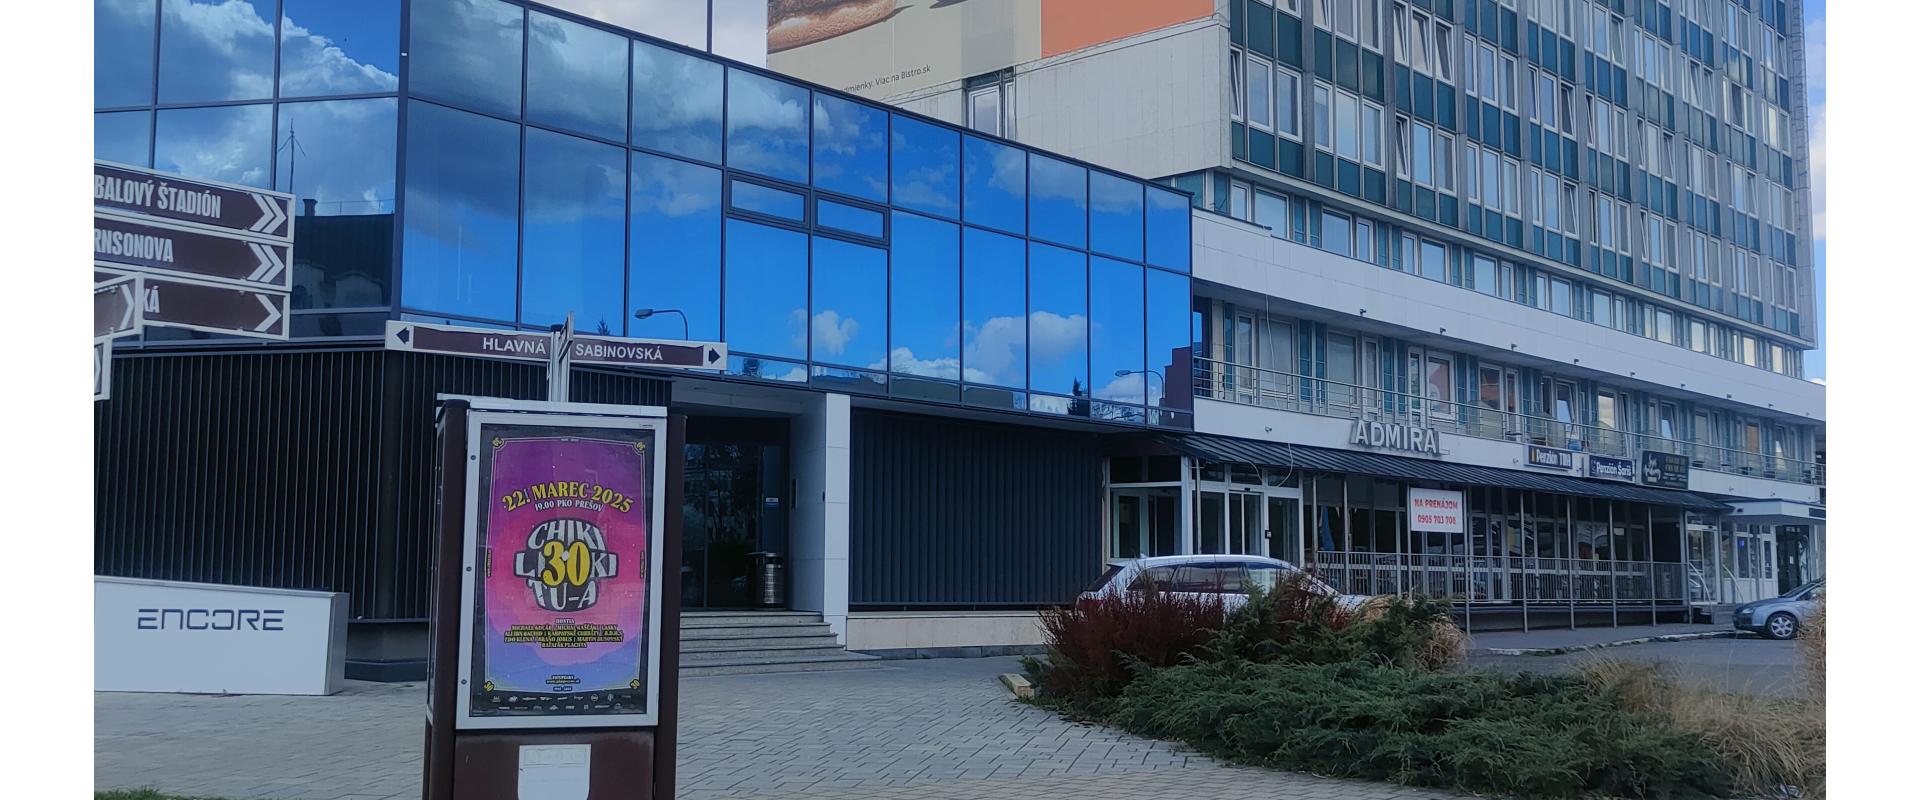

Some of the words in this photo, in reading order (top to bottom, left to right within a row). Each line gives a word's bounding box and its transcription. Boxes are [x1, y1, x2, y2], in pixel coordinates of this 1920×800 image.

[844, 81, 874, 93] mienky.
[875, 77, 890, 86] Viac
[891, 74, 900, 82] na
[901, 64, 931, 80] Bistro.sk
[94, 174, 154, 207] BALOVÝ
[157, 182, 221, 219] ŠTADIÓN
[94, 228, 174, 263] RNSONOVA
[482, 337, 546, 356] HLAVNÁ
[575, 343, 663, 361] SABINOVSKÁ
[532, 481, 589, 501] MAREC
[592, 485, 634, 513] 2025
[534, 500, 555, 511] 19.00
[557, 499, 573, 508] PKO
[575, 499, 604, 512] PREŠOV
[1414, 498, 1424, 507] NA
[528, 520, 606, 551] CHIKI
[543, 541, 590, 586] 30
[138, 609, 285, 631] ENCORE
